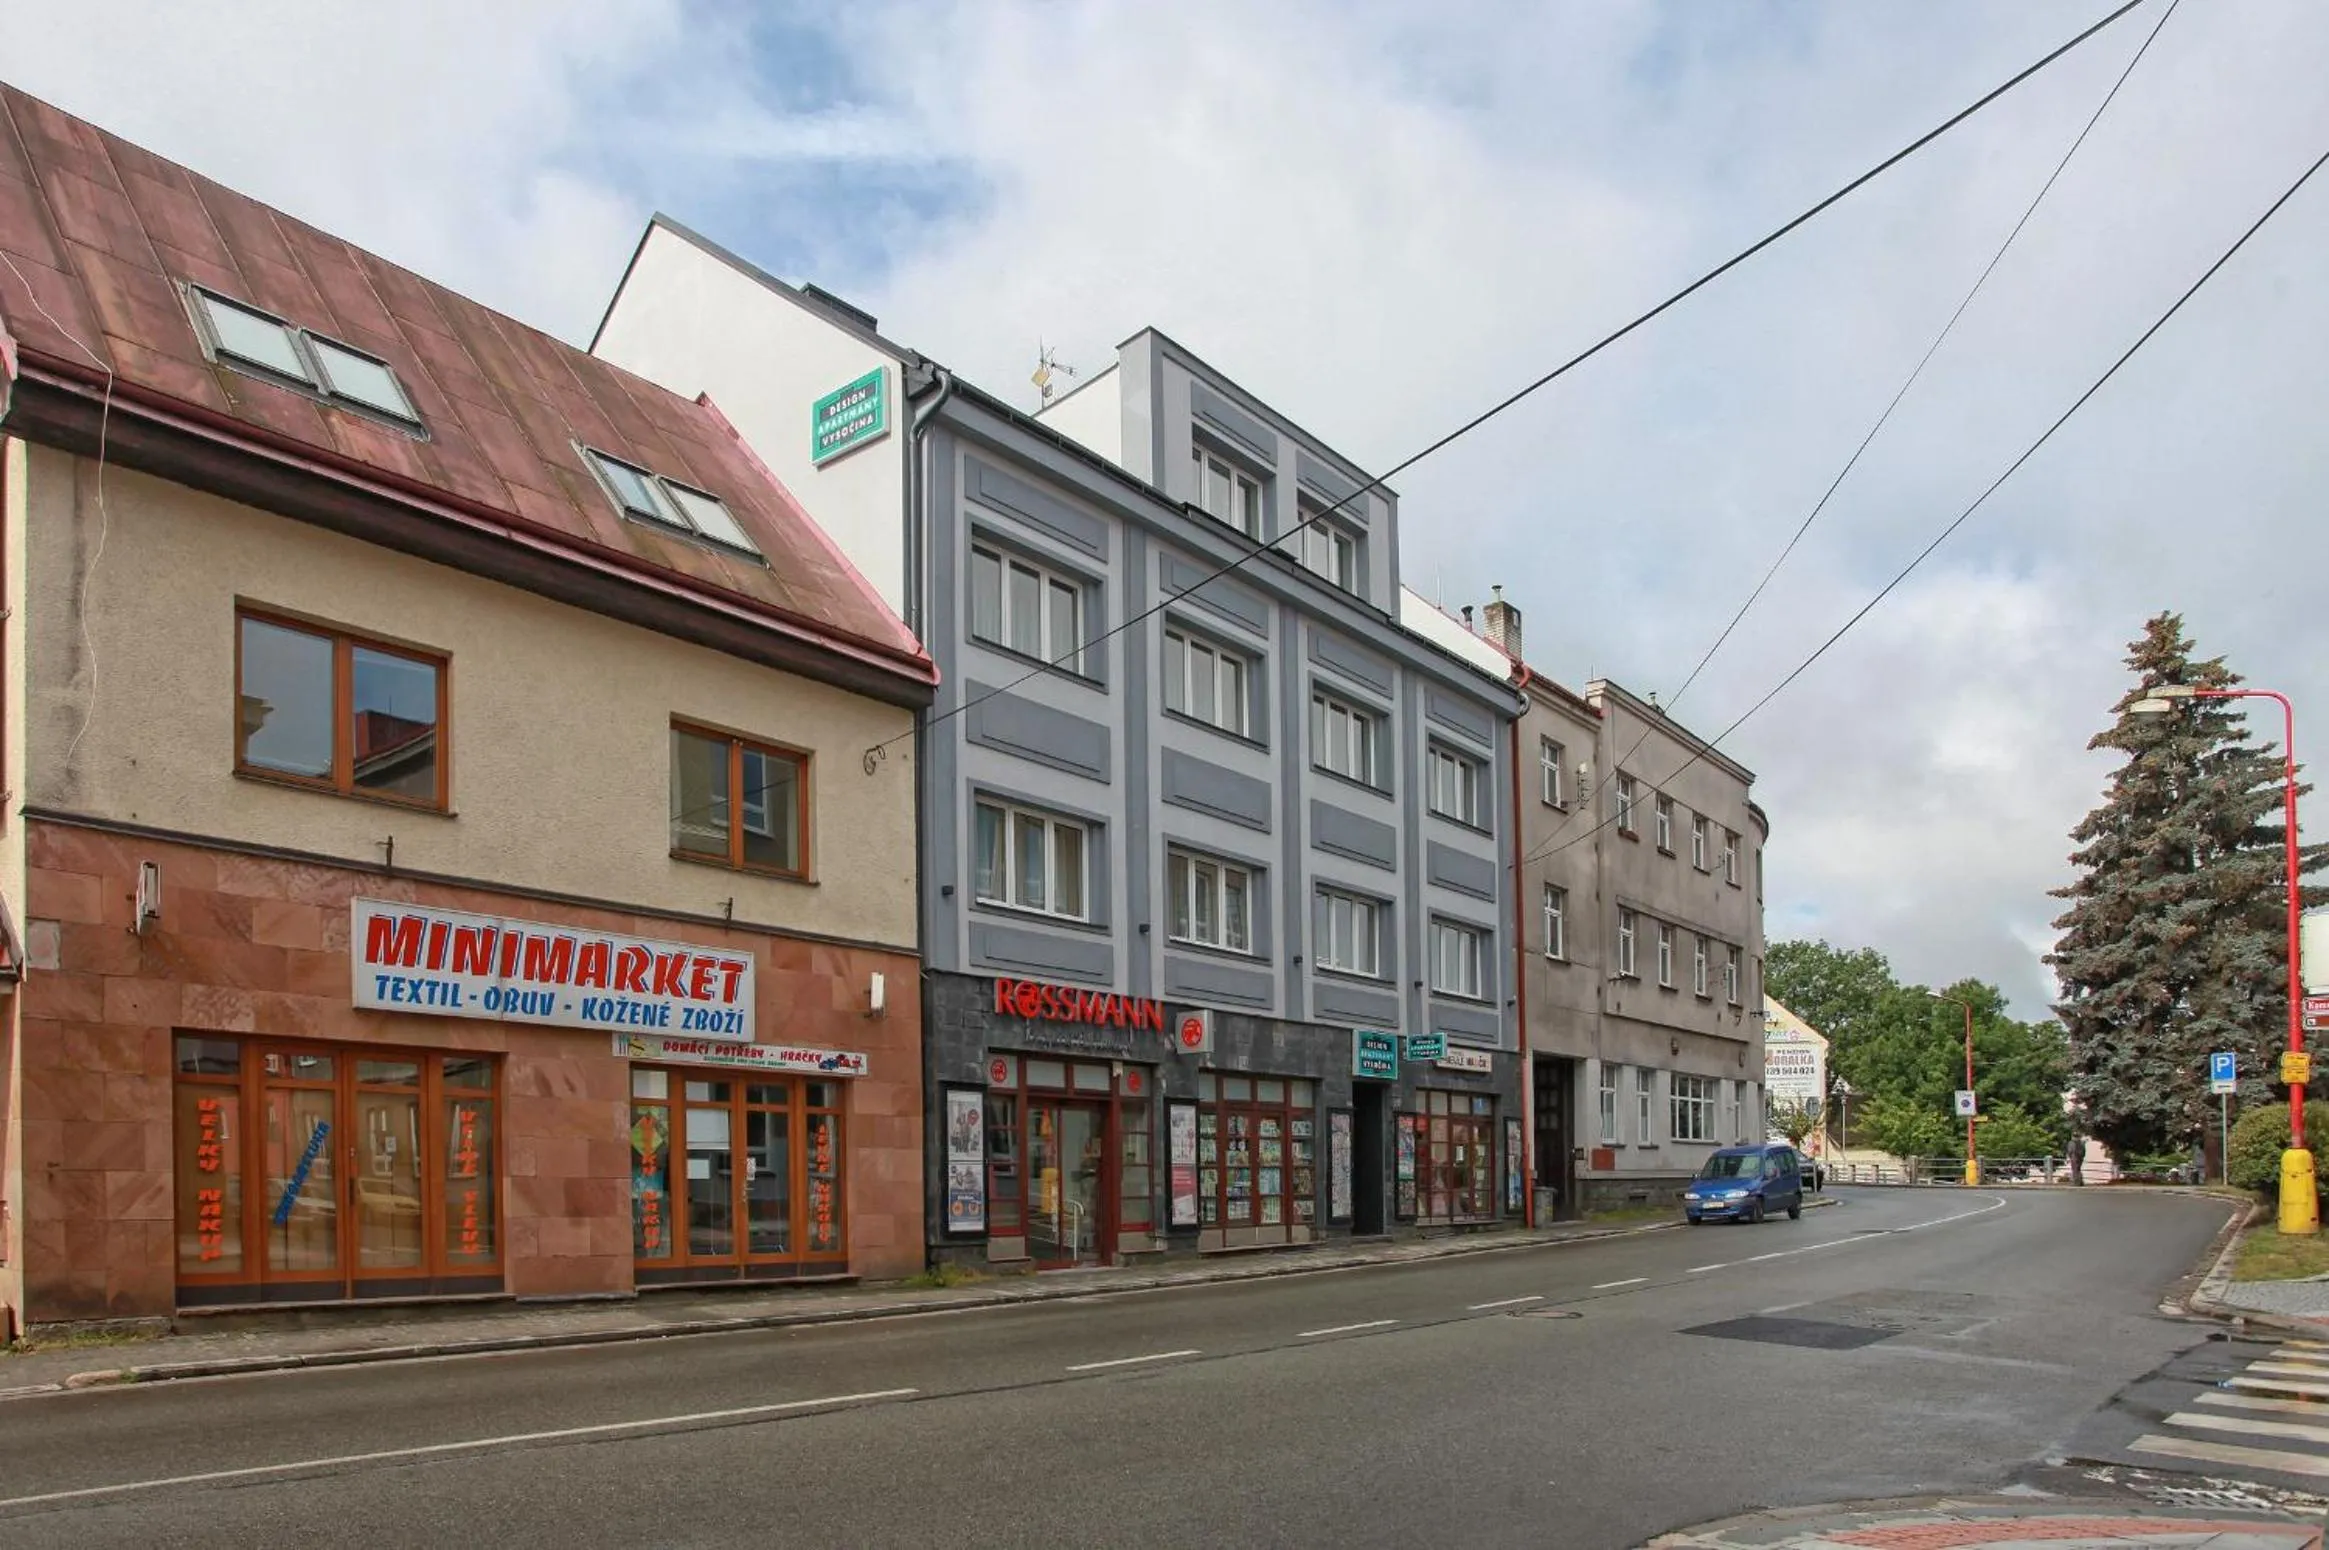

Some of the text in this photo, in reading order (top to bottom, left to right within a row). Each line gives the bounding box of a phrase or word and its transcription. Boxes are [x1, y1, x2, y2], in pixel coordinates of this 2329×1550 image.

[830, 389, 866, 416] DESIGN
[365, 913, 748, 1004] MINIMARKET
[375, 975, 462, 1008] TEXTIL
[484, 986, 554, 1017] OBUV
[582, 996, 670, 1028] KOŽENÉ
[681, 1008, 744, 1035] ZBOŽÍ
[995, 978, 1164, 1032] ROSSMANN
[2217, 1057, 2230, 1072] P
